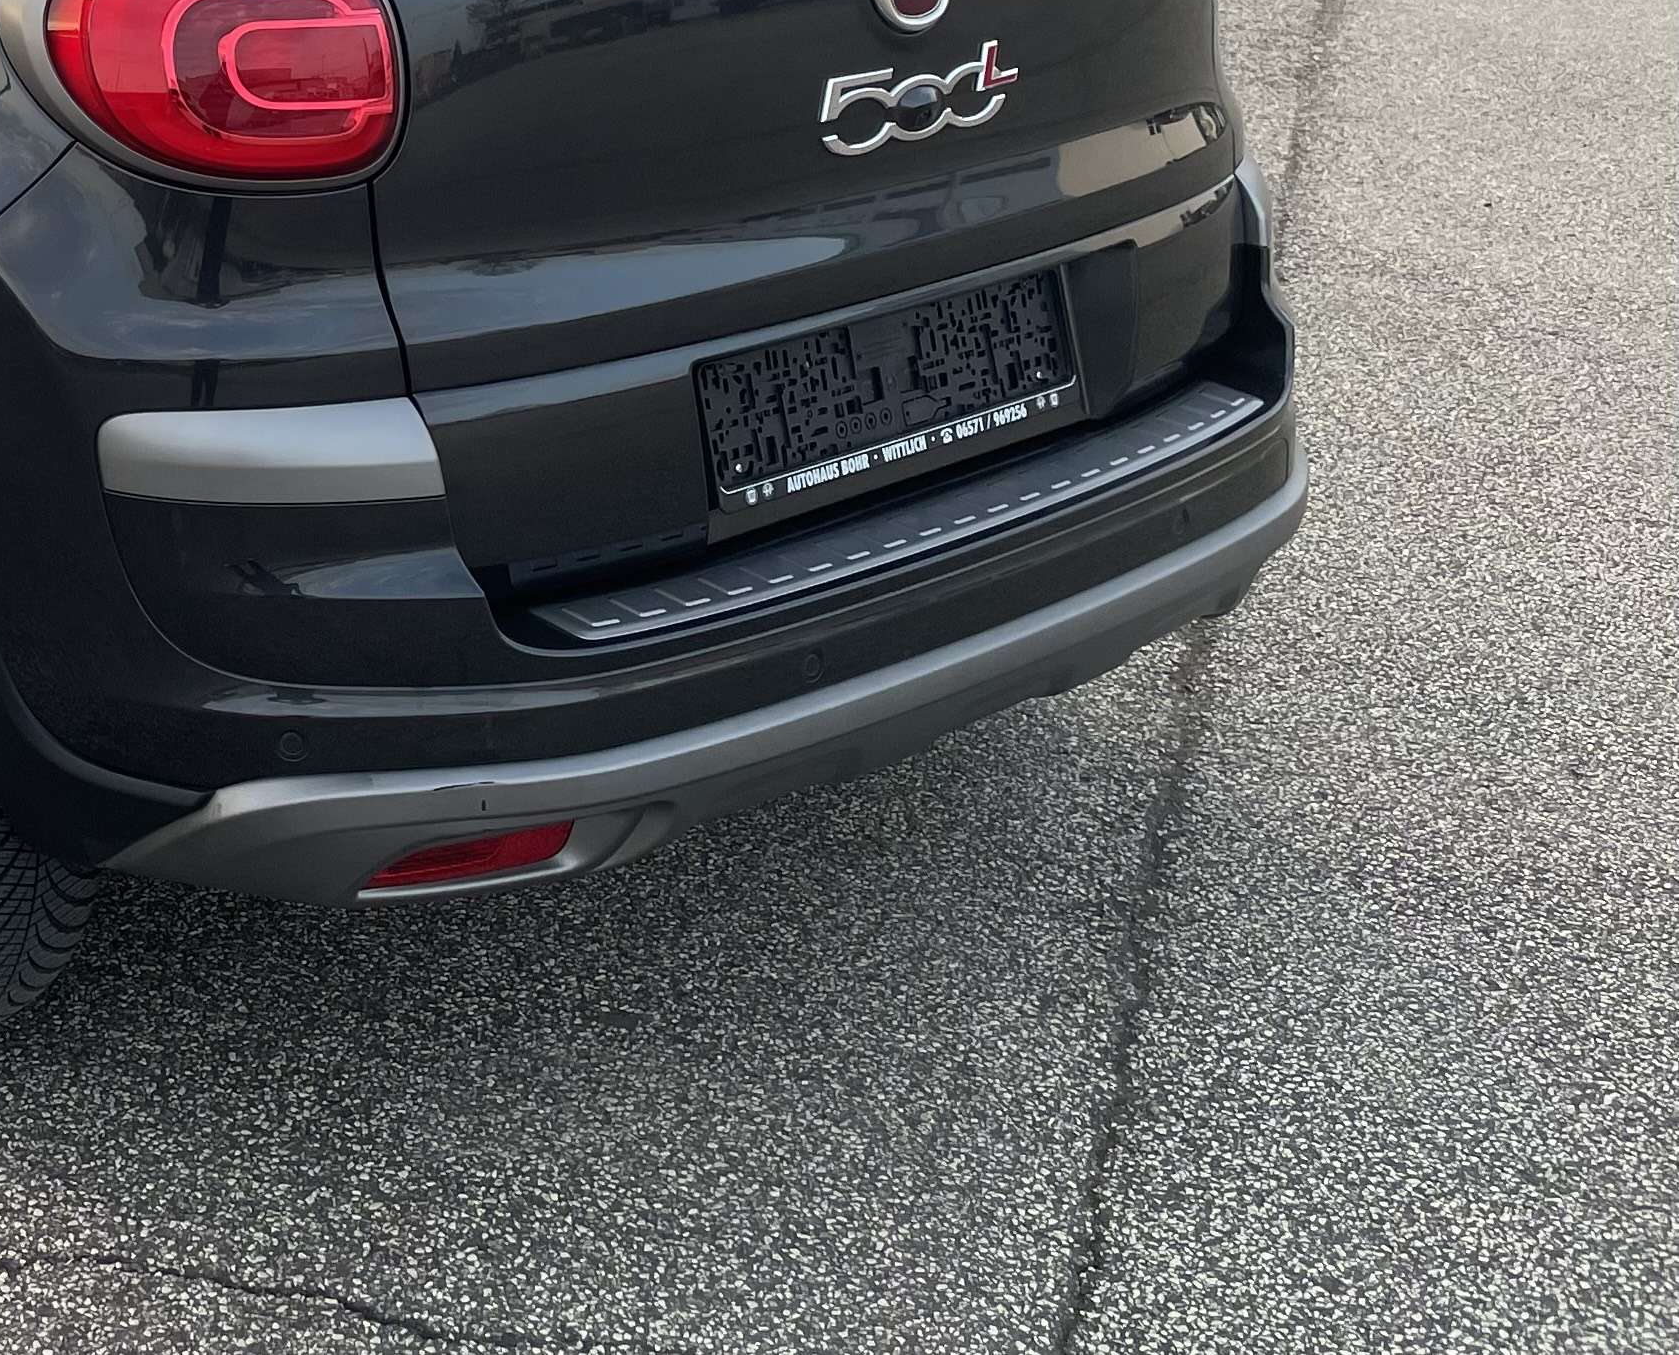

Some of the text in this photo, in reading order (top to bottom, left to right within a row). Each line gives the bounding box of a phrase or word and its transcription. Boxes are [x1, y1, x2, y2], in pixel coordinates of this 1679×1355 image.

[786, 462, 840, 494] AUTOHAUS
[841, 453, 871, 476] BOHR
[881, 434, 928, 463] WITTLICH
[955, 417, 985, 439] 06571
[992, 403, 1028, 427] 969256
